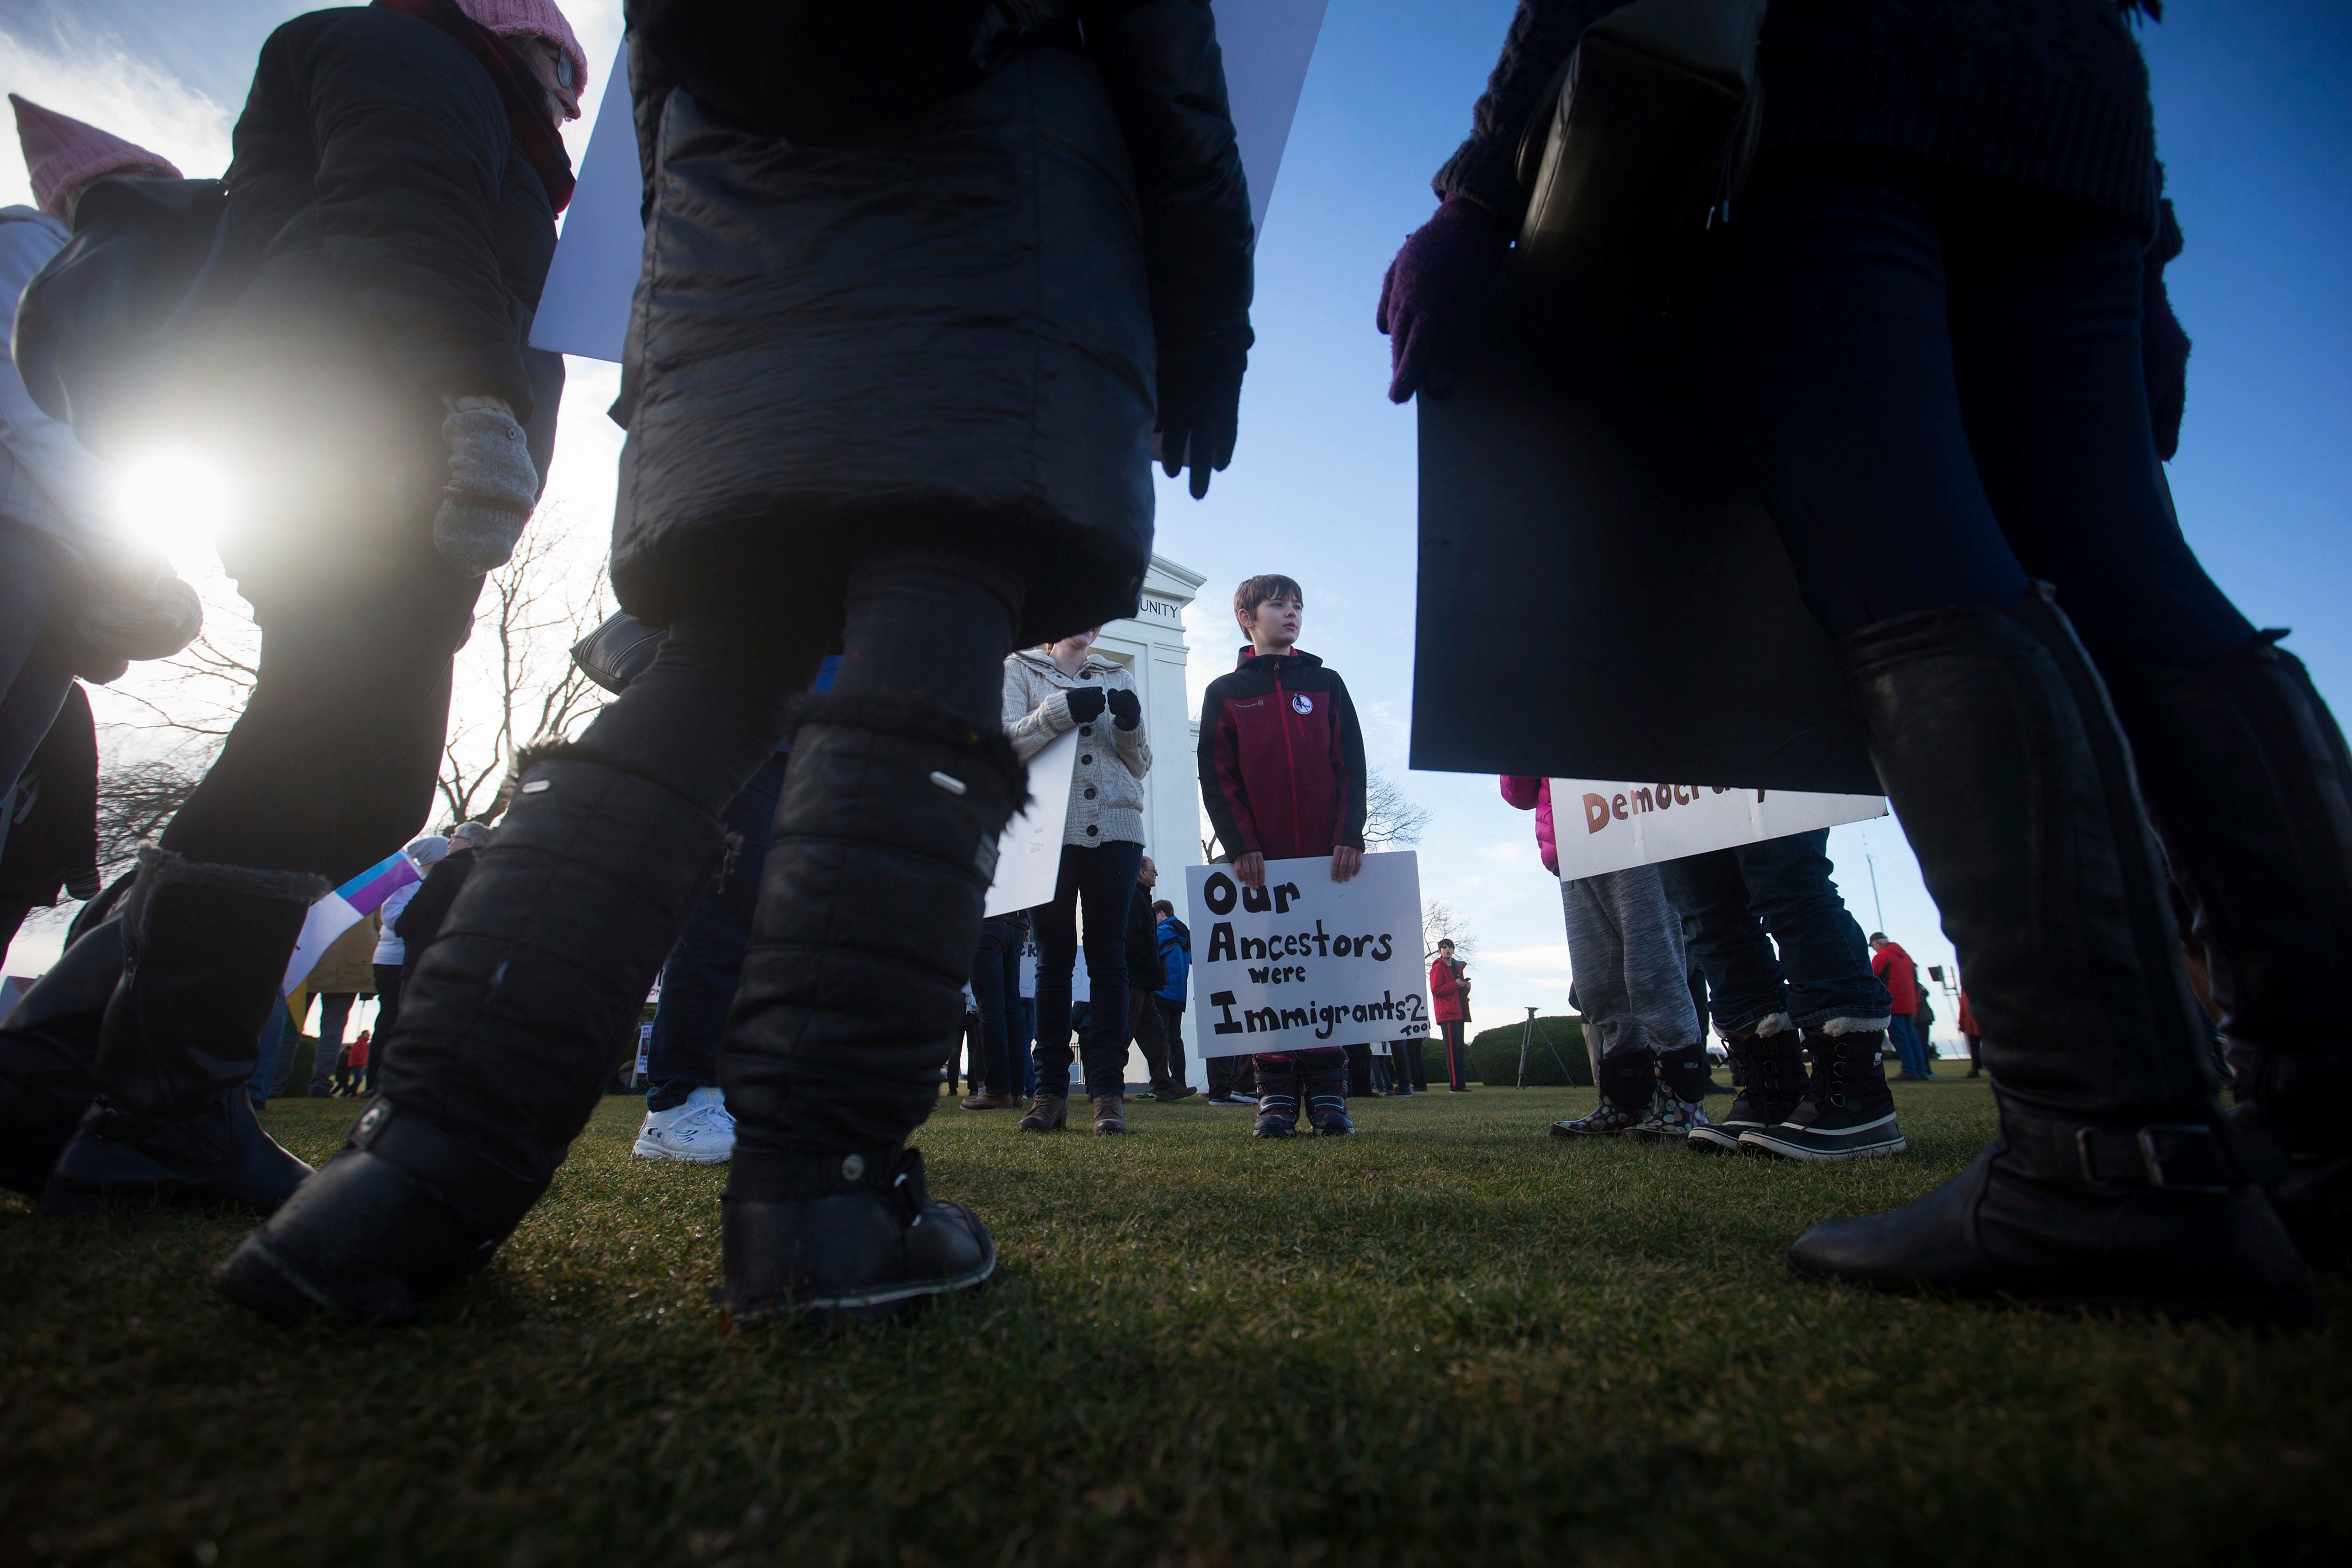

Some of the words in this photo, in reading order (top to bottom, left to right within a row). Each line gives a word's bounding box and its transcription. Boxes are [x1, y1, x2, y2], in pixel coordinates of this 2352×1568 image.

[1140, 598, 1178, 618] UNITY
[1581, 783, 1765, 834] Democ
[1204, 871, 1301, 915] Our
[1207, 919, 1392, 963] Ancestors
[1248, 966, 1306, 984] were
[1210, 990, 1406, 1039] Immigrants
[1400, 1022, 1428, 1037] TOO
